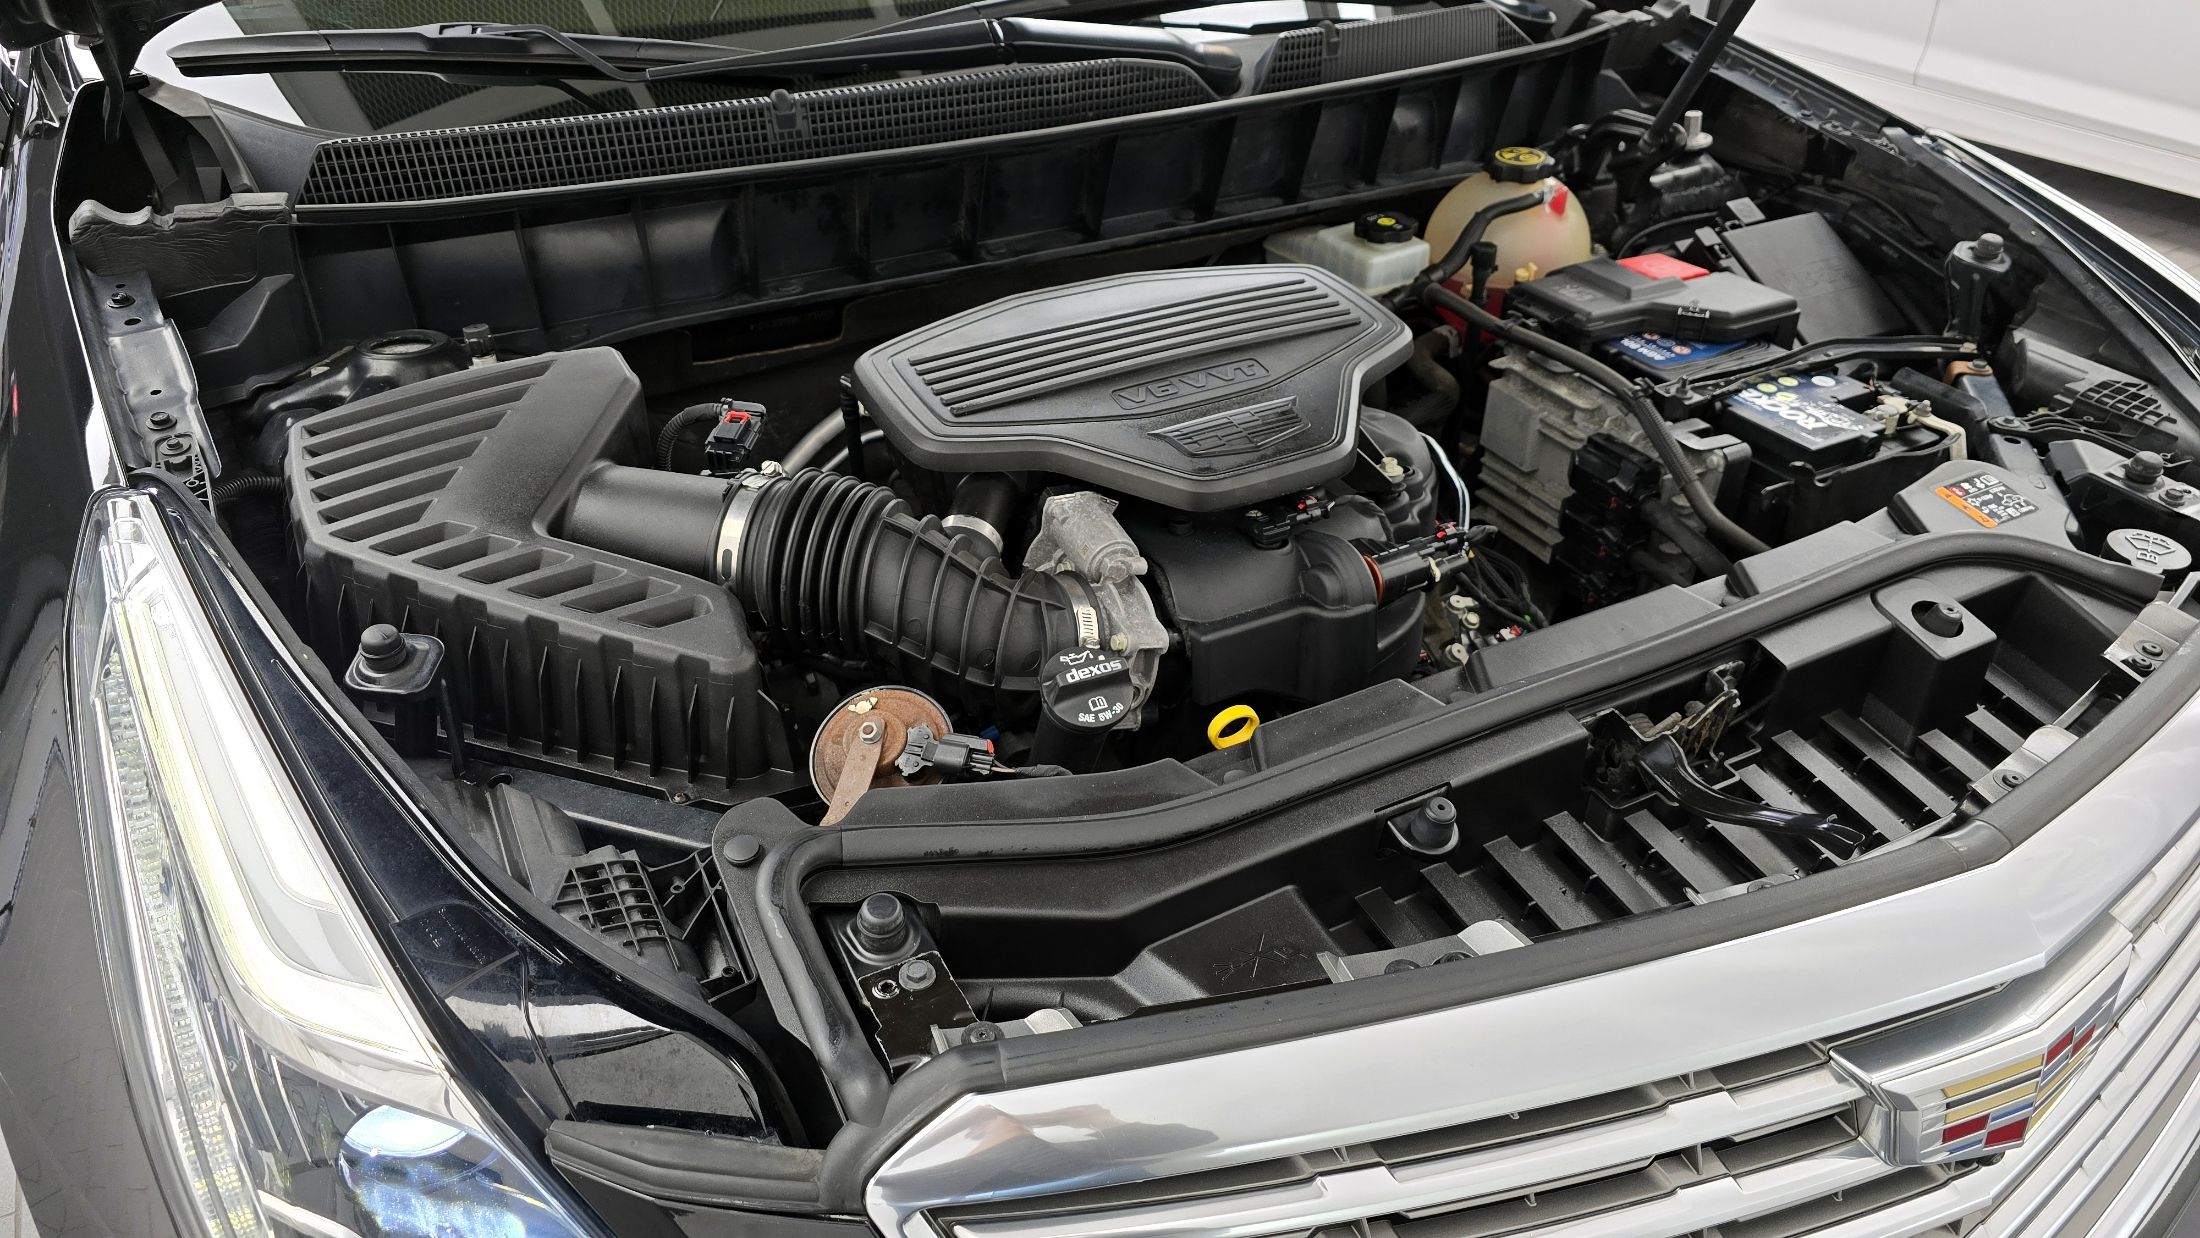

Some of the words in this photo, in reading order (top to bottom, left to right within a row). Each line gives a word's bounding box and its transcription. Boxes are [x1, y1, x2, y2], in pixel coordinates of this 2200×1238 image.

[1117, 378, 1179, 403] V6
[1178, 362, 1256, 389] VVT
[1065, 660, 1122, 683] dexos
[1078, 713, 1096, 723] SAE
[1098, 702, 1124, 722] 5W-30
